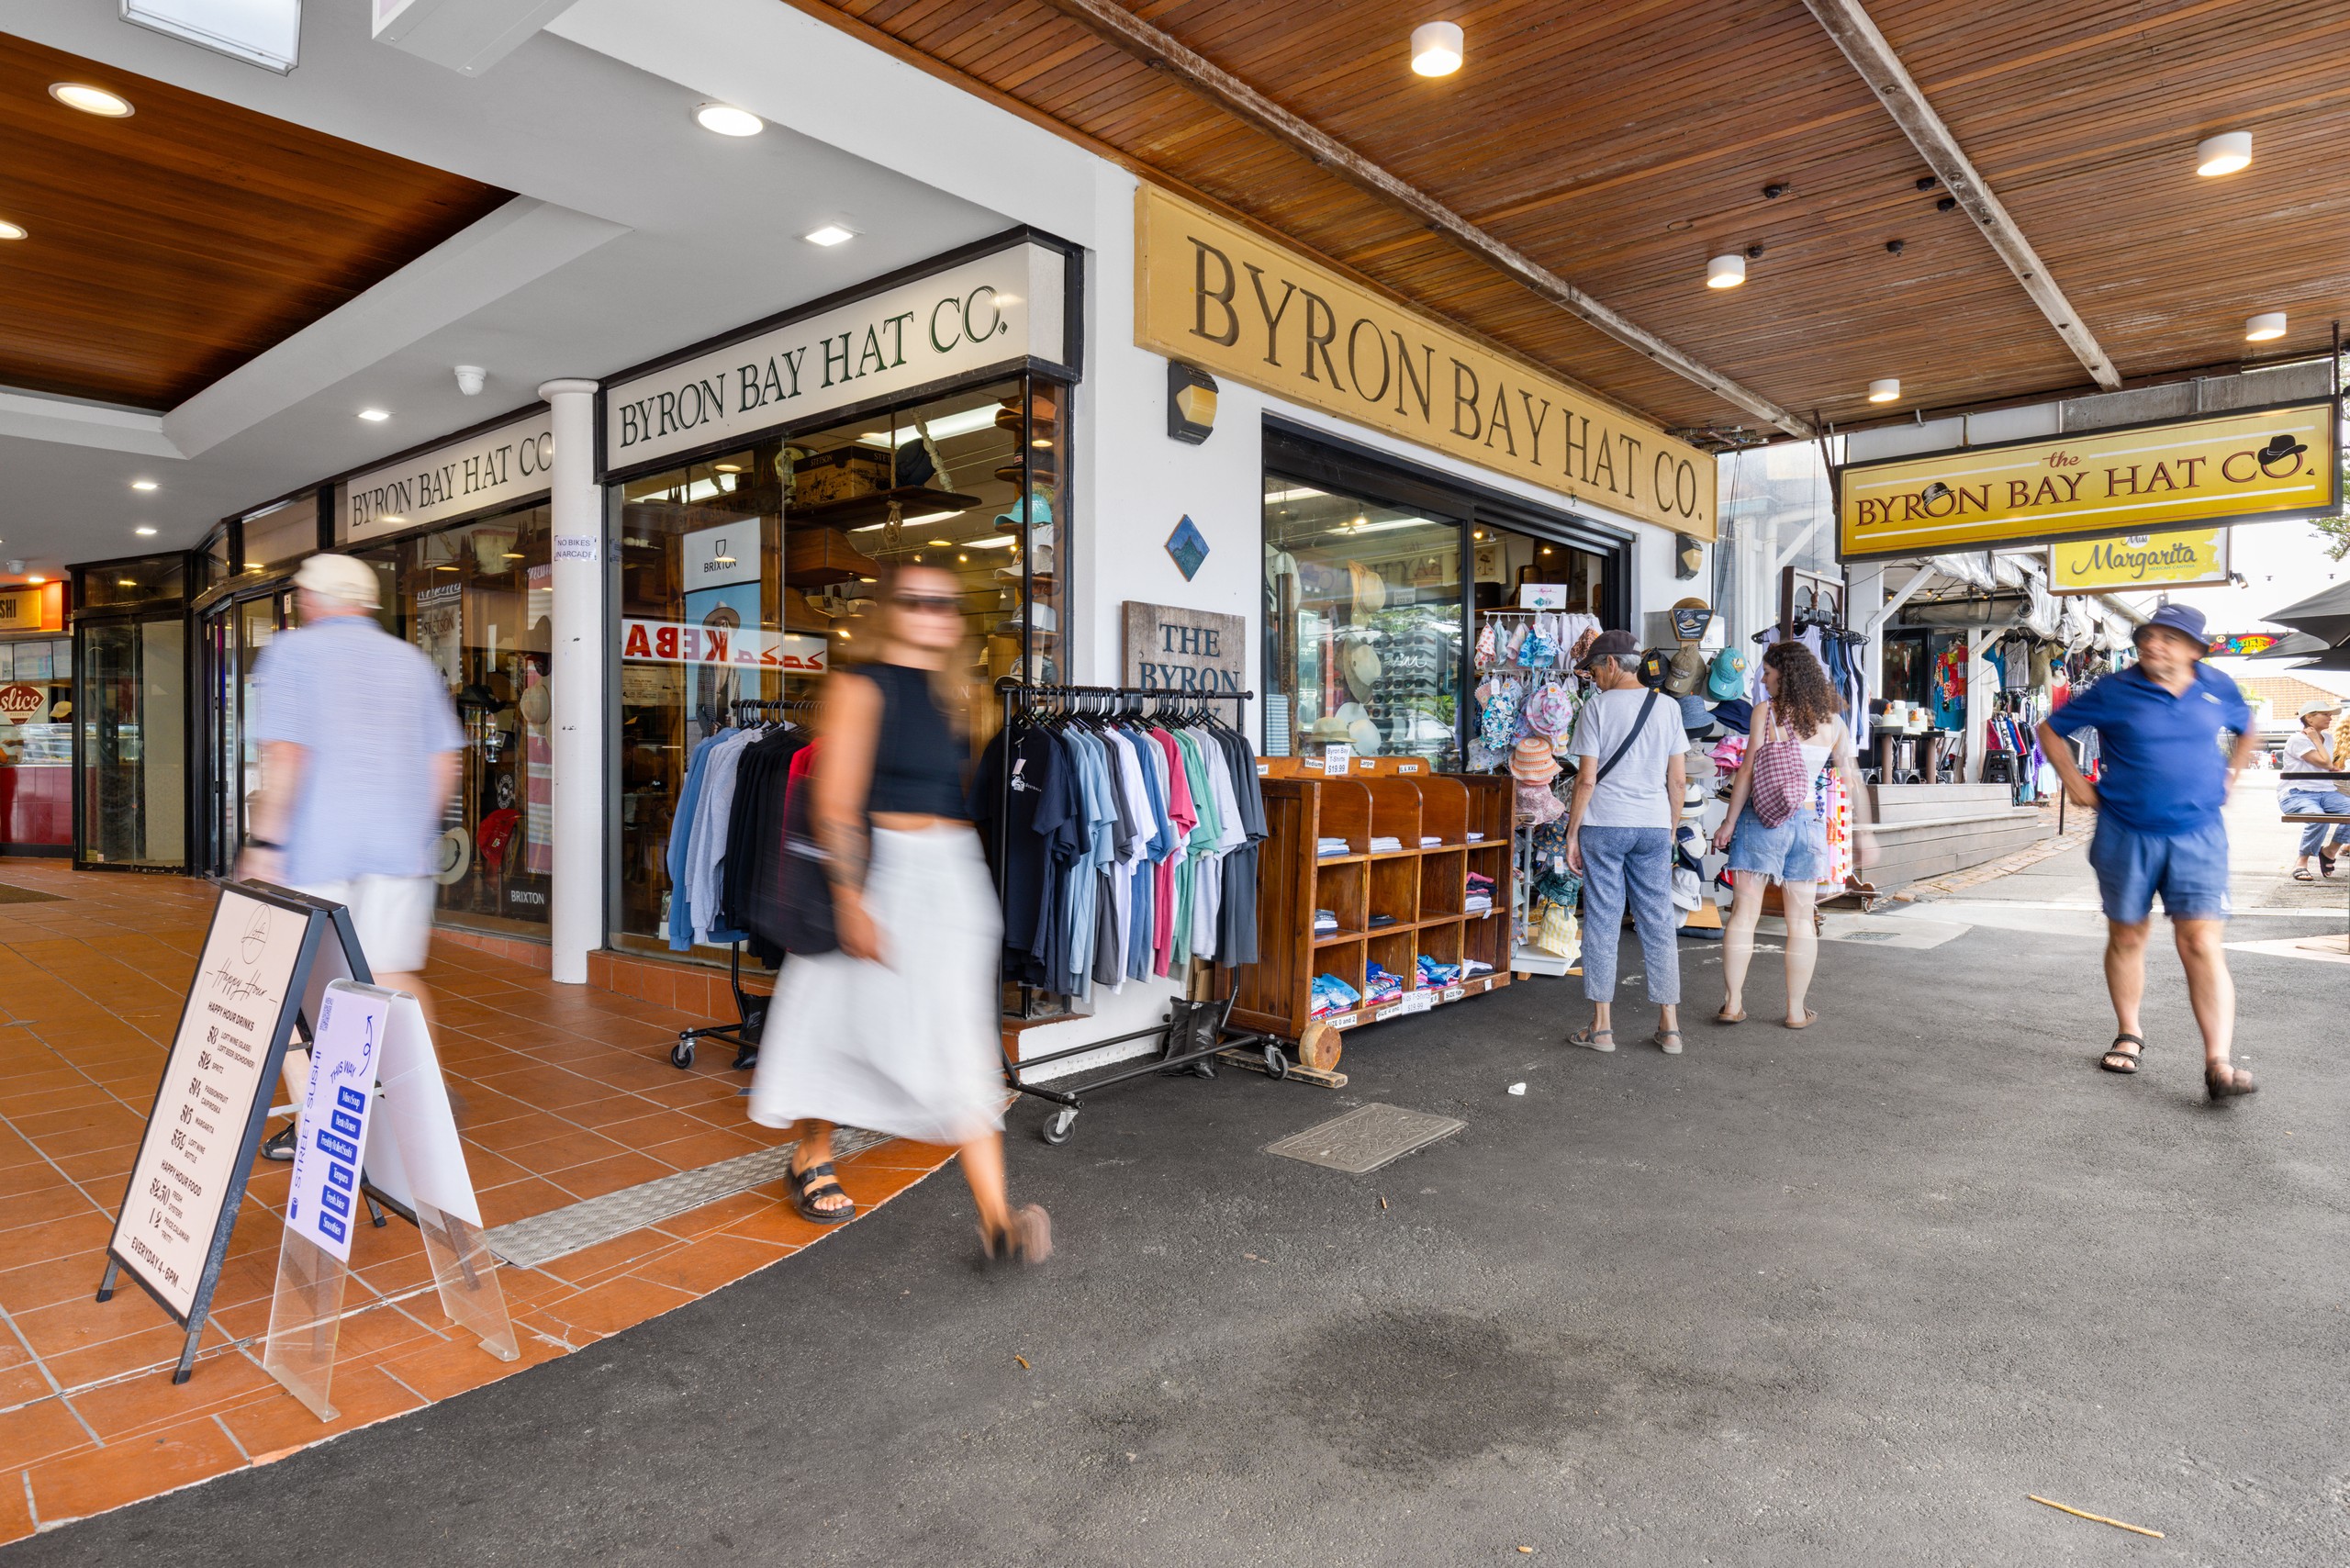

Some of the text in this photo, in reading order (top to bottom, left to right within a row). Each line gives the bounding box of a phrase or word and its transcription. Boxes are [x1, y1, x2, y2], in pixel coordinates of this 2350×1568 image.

[619, 285, 1008, 448] BYRON BAY HAT CO.
[1187, 235, 1702, 521] BYRON BAY HAT CO.
[811, 454, 834, 466] STETSON
[2042, 450, 2080, 469] the
[352, 477, 413, 527] BYRON
[418, 463, 457, 509] BAY
[463, 444, 512, 496] HAT
[1855, 483, 1993, 527] BYRON
[2006, 472, 2090, 509] BAY
[2103, 455, 2207, 498] HAT
[2121, 534, 2148, 545] Miss
[703, 558, 737, 573] BRIXTON
[2071, 542, 2198, 579] Margarita
[1159, 623, 1221, 658] THE
[1138, 662, 1241, 693] BYRON
[1, 688, 39, 711] slice
[1327, 747, 1339, 756] Byron
[1304, 759, 1324, 767] Medium
[1327, 765, 1346, 773] $19.99
[510, 890, 544, 905] BRIXTON
[212, 958, 268, 1001] Happy Hour
[1412, 991, 1431, 1001] T-Shirts
[1445, 991, 1455, 999] SIZE
[207, 1001, 255, 1032] HAPPY HOUR DRINKS
[1407, 1002, 1424, 1013] $19.99
[1342, 1016, 1351, 1025] and
[207, 1025, 219, 1045] $8
[220, 1031, 230, 1042] LOFT
[229, 1035, 240, 1047] WINE
[197, 1050, 212, 1070] $12
[217, 1043, 227, 1054] LOFT
[225, 1047, 235, 1058] BEER
[211, 1061, 225, 1074] SPRITZ
[330, 1059, 357, 1084] THIS WAY
[188, 1077, 202, 1098] $14
[204, 1084, 229, 1104] PASSIONFRUIT
[341, 1090, 361, 1110] Miso Soup
[180, 1103, 194, 1126] $15
[295, 1050, 322, 1189] STREET SUSHI
[335, 1114, 346, 1127] Bento
[195, 1116, 215, 1135] MARGARITA
[187, 1137, 207, 1155] LOFT WINE
[320, 1133, 353, 1159] Freshly Rolled Sushi
[184, 1149, 198, 1164] BOTTLE
[161, 1159, 202, 1197] HAPPY HOUR FOOD
[332, 1166, 350, 1185] Tempura
[172, 1190, 184, 1204] FRESH
[325, 1190, 346, 1210] Fresh Juice
[167, 1203, 184, 1219] OYSTERS
[163, 1216, 190, 1244] PRICE CALAMARI
[322, 1216, 342, 1237] Smoothies
[130, 1237, 158, 1270] EVERYDAY
